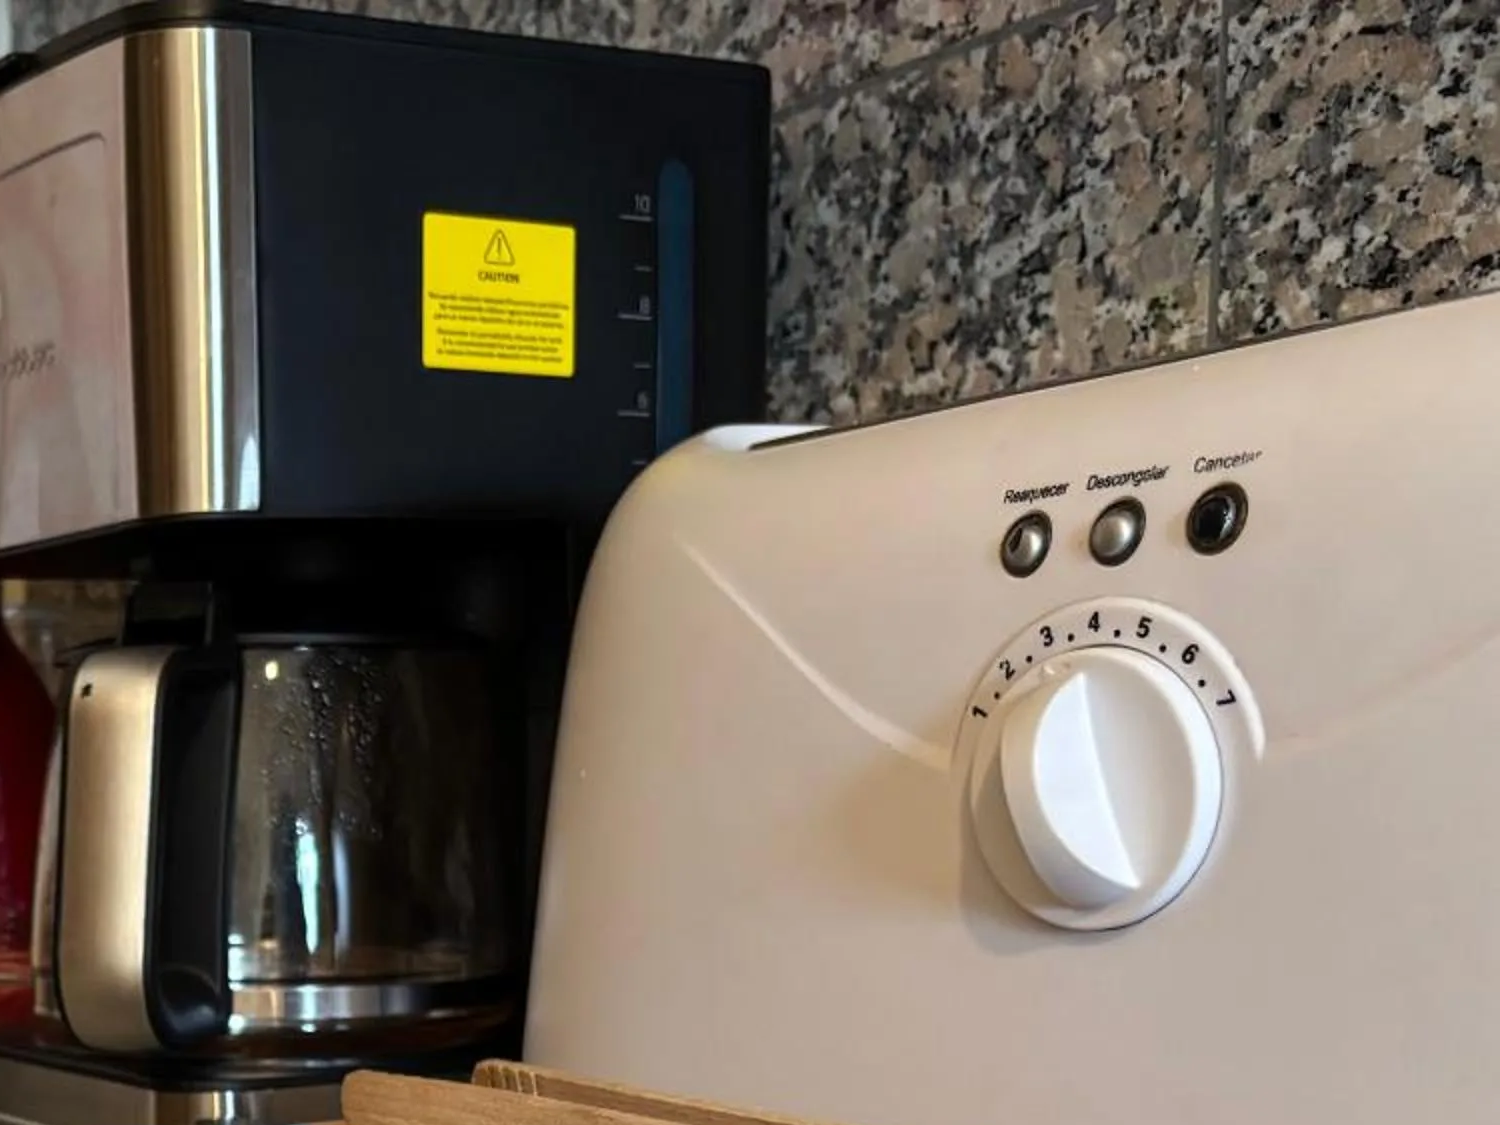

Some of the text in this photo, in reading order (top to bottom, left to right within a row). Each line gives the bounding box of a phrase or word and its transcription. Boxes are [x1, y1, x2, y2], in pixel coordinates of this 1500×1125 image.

[634, 194, 651, 213] 10
[477, 269, 520, 285] CAUTION
[1002, 480, 1070, 505] Reaquecer
[971, 611, 1238, 720] 1 2 3 4 5 6 7
